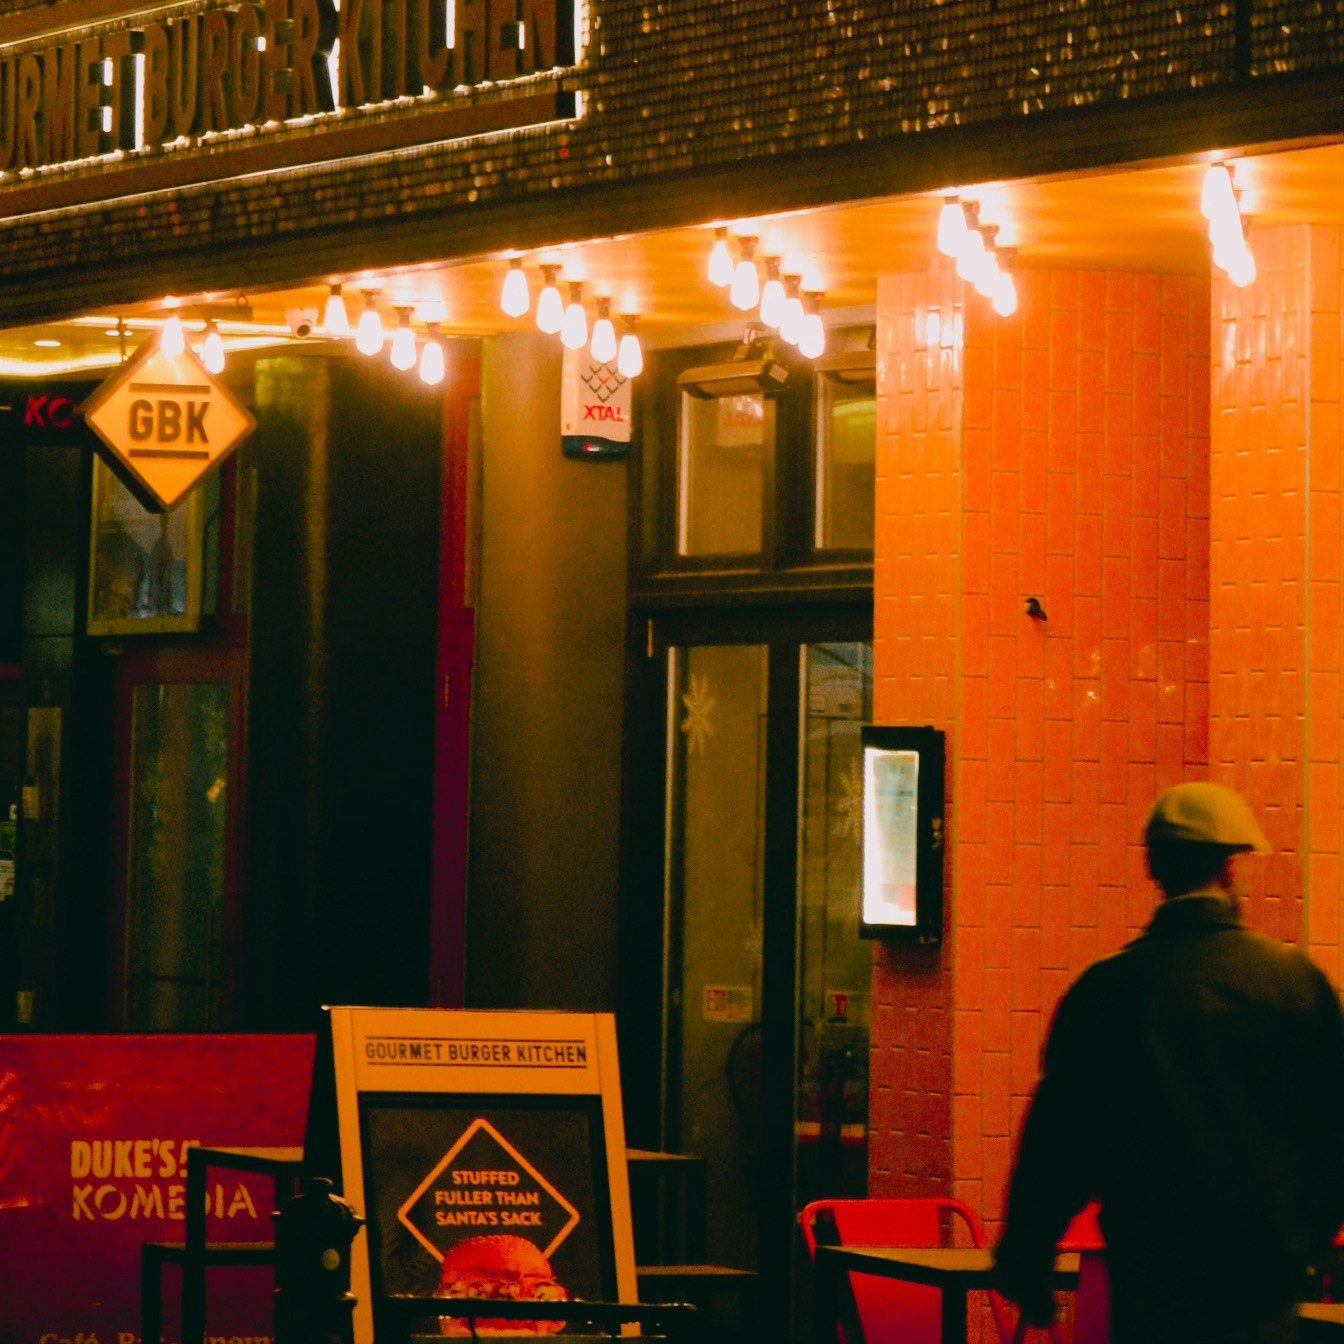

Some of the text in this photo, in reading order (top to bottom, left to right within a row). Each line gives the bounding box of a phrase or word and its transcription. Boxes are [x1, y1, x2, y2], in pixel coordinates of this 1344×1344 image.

[130, 399, 211, 443] GBK
[366, 1043, 587, 1063] GOURMET BURGER KITCHEN
[70, 1138, 177, 1179] DUKE'S
[452, 1170, 520, 1186] STUFFED
[72, 1183, 258, 1221] KOMEIA
[435, 1190, 539, 1206] FULLER THAN
[435, 1210, 542, 1226] SANTA'S SACK
